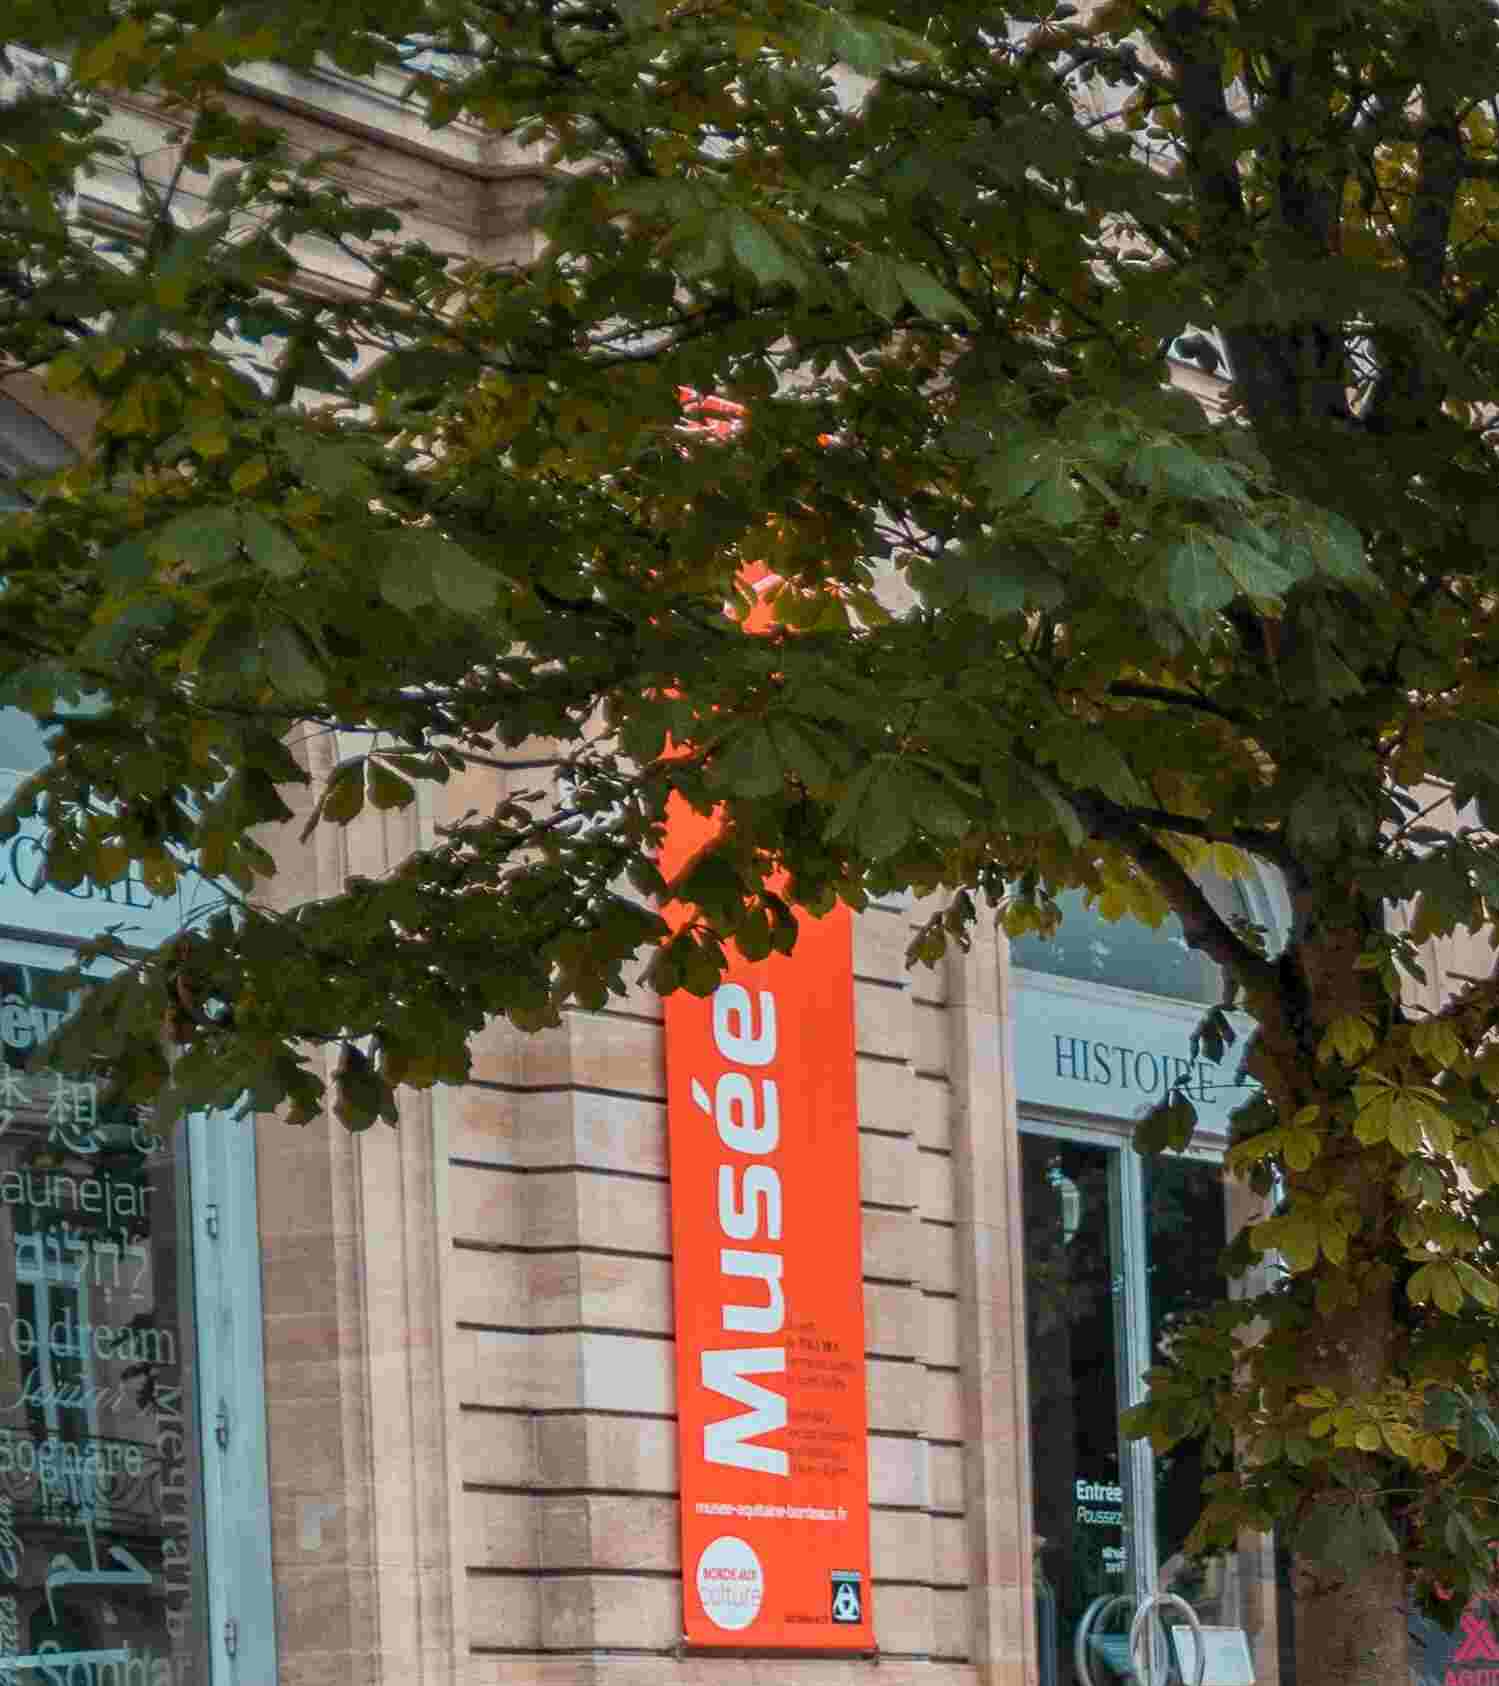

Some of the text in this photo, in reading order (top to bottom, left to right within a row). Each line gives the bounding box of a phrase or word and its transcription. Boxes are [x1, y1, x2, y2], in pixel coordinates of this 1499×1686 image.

[1053, 1034, 1217, 1104] HISTOIRE
[0, 1169, 158, 1230] aunejar
[691, 982, 789, 1479] Musée
[50, 1304, 177, 1368] dream
[1076, 1479, 1123, 1502] Entrée
